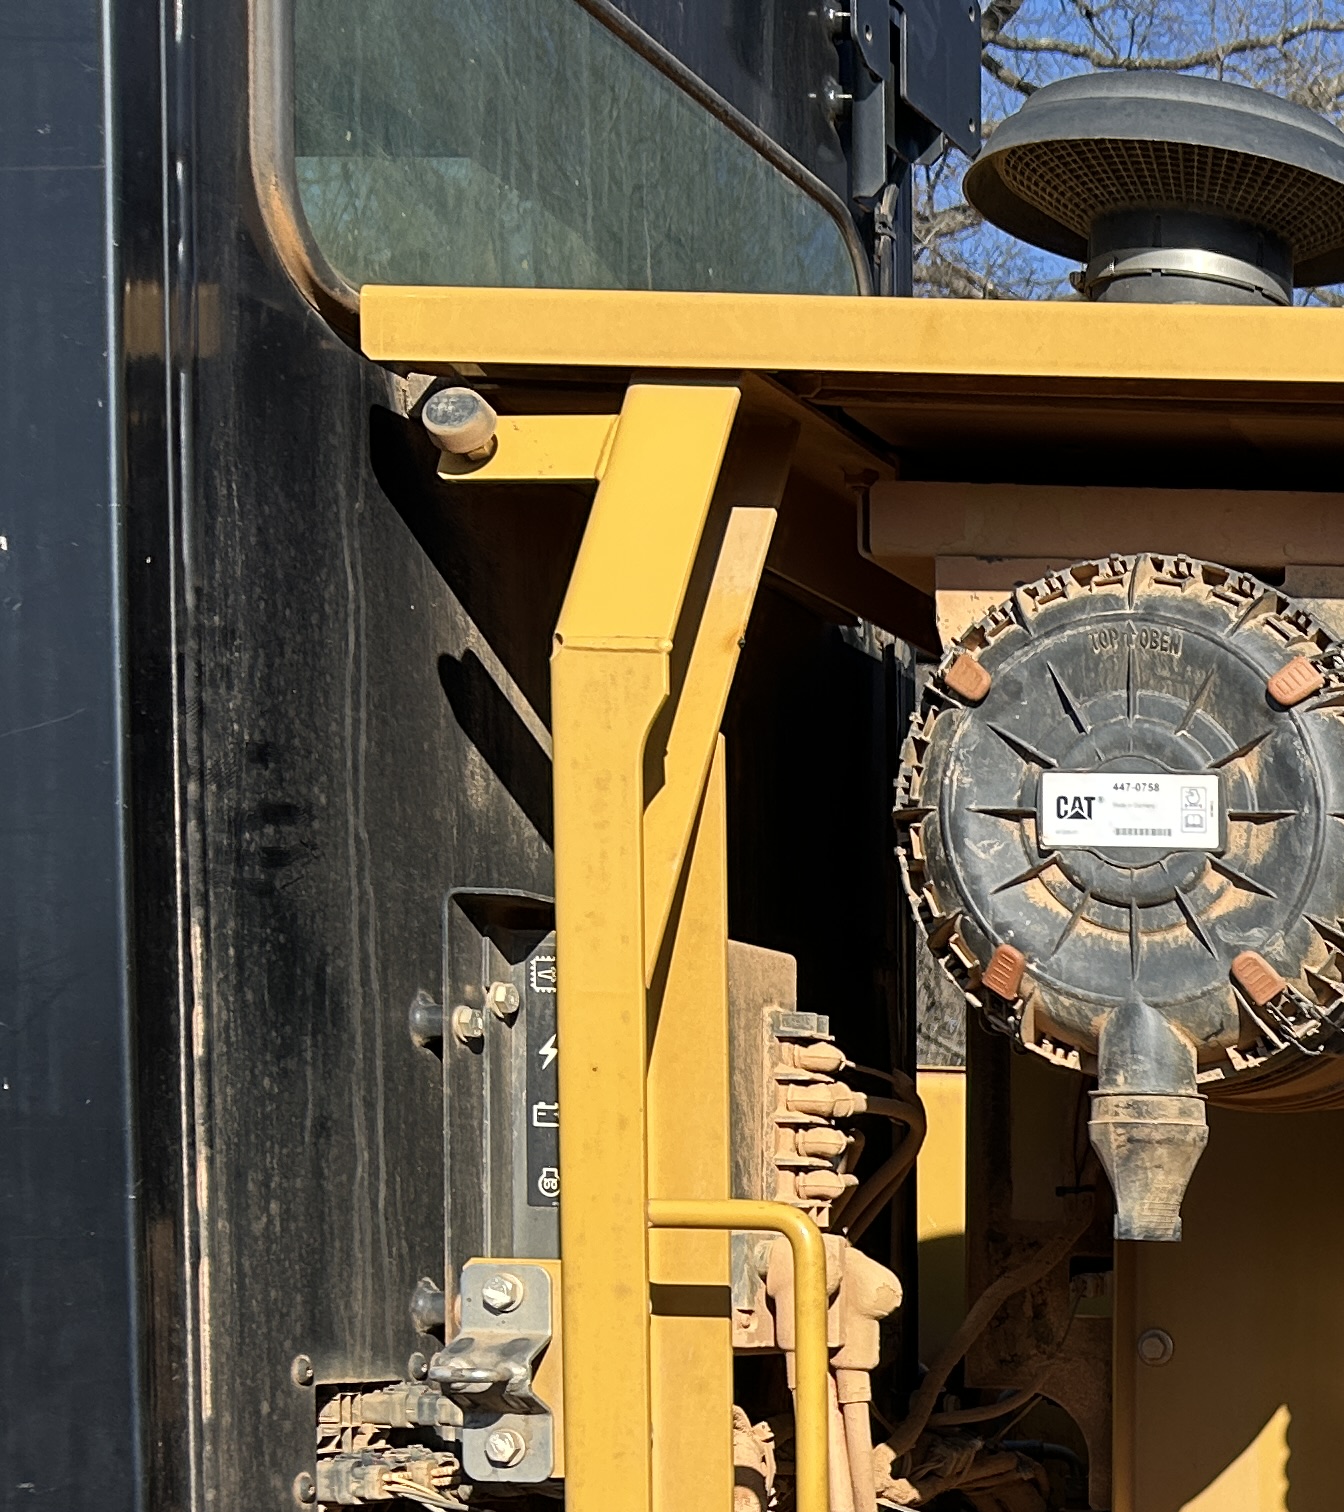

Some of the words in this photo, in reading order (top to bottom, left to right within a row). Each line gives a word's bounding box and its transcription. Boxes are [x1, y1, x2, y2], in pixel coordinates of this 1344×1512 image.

[1088, 627, 1119, 655] TOP
[1140, 625, 1183, 658] OBEN
[1112, 782, 1160, 792] 447-0758
[1056, 795, 1096, 820] CAT
